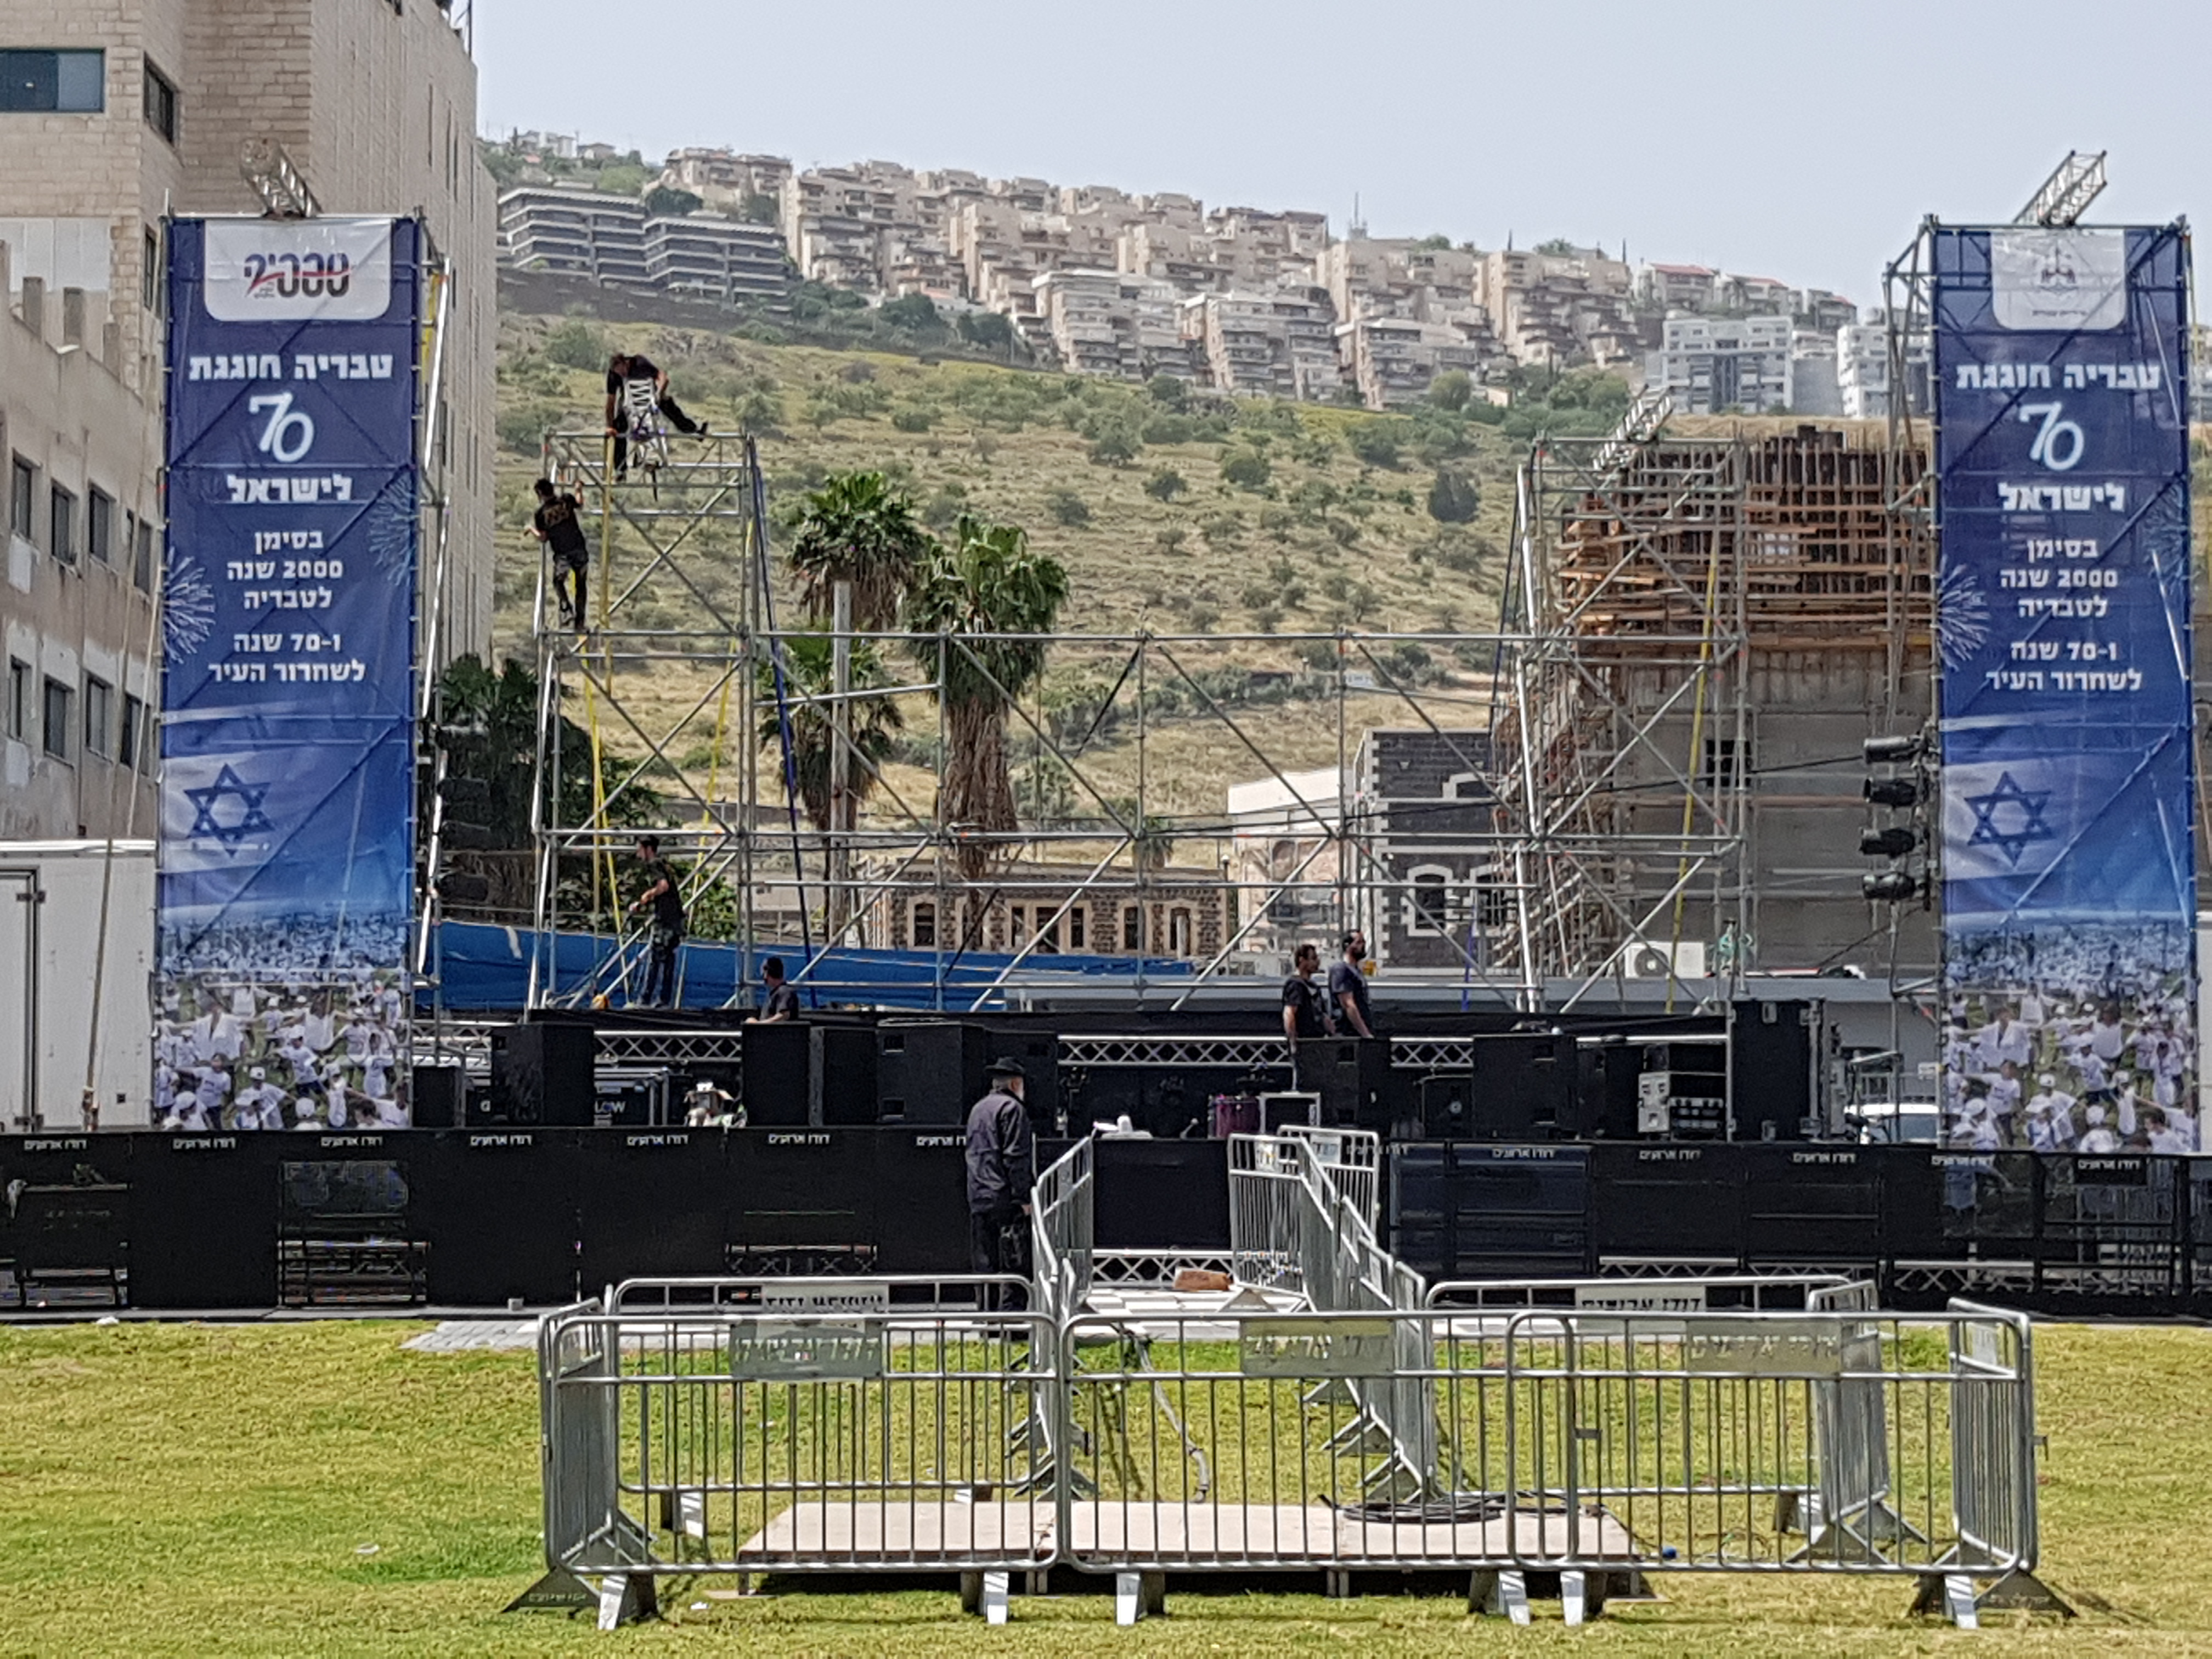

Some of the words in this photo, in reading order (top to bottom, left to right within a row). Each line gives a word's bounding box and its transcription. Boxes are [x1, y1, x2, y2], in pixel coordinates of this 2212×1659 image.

[189, 354, 281, 380] חוגגת
[295, 354, 393, 379] טבריה
[1956, 364, 2051, 390] חוגגת
[2063, 364, 2161, 390] טבריה
[249, 392, 314, 462] 70
[2018, 401, 2084, 471] 70
[227, 473, 352, 504] לישראל
[1998, 482, 2125, 512] לישראל
[255, 530, 323, 554] בסימן
[2027, 538, 2099, 563] בסימן
[227, 561, 275, 579] שנה
[283, 560, 343, 579] 2000
[2000, 569, 2049, 588] שנה
[2058, 569, 2118, 588] 2000
[244, 586, 332, 609] לטבריה
[2018, 595, 2108, 618] לטבריה
[234, 634, 282, 652] שנה
[2011, 641, 2059, 661] שנה
[208, 663, 266, 682] העיר
[273, 658, 365, 681] לשחרור
[1986, 671, 2043, 691] העיר
[2051, 668, 2142, 691] לשחרור
